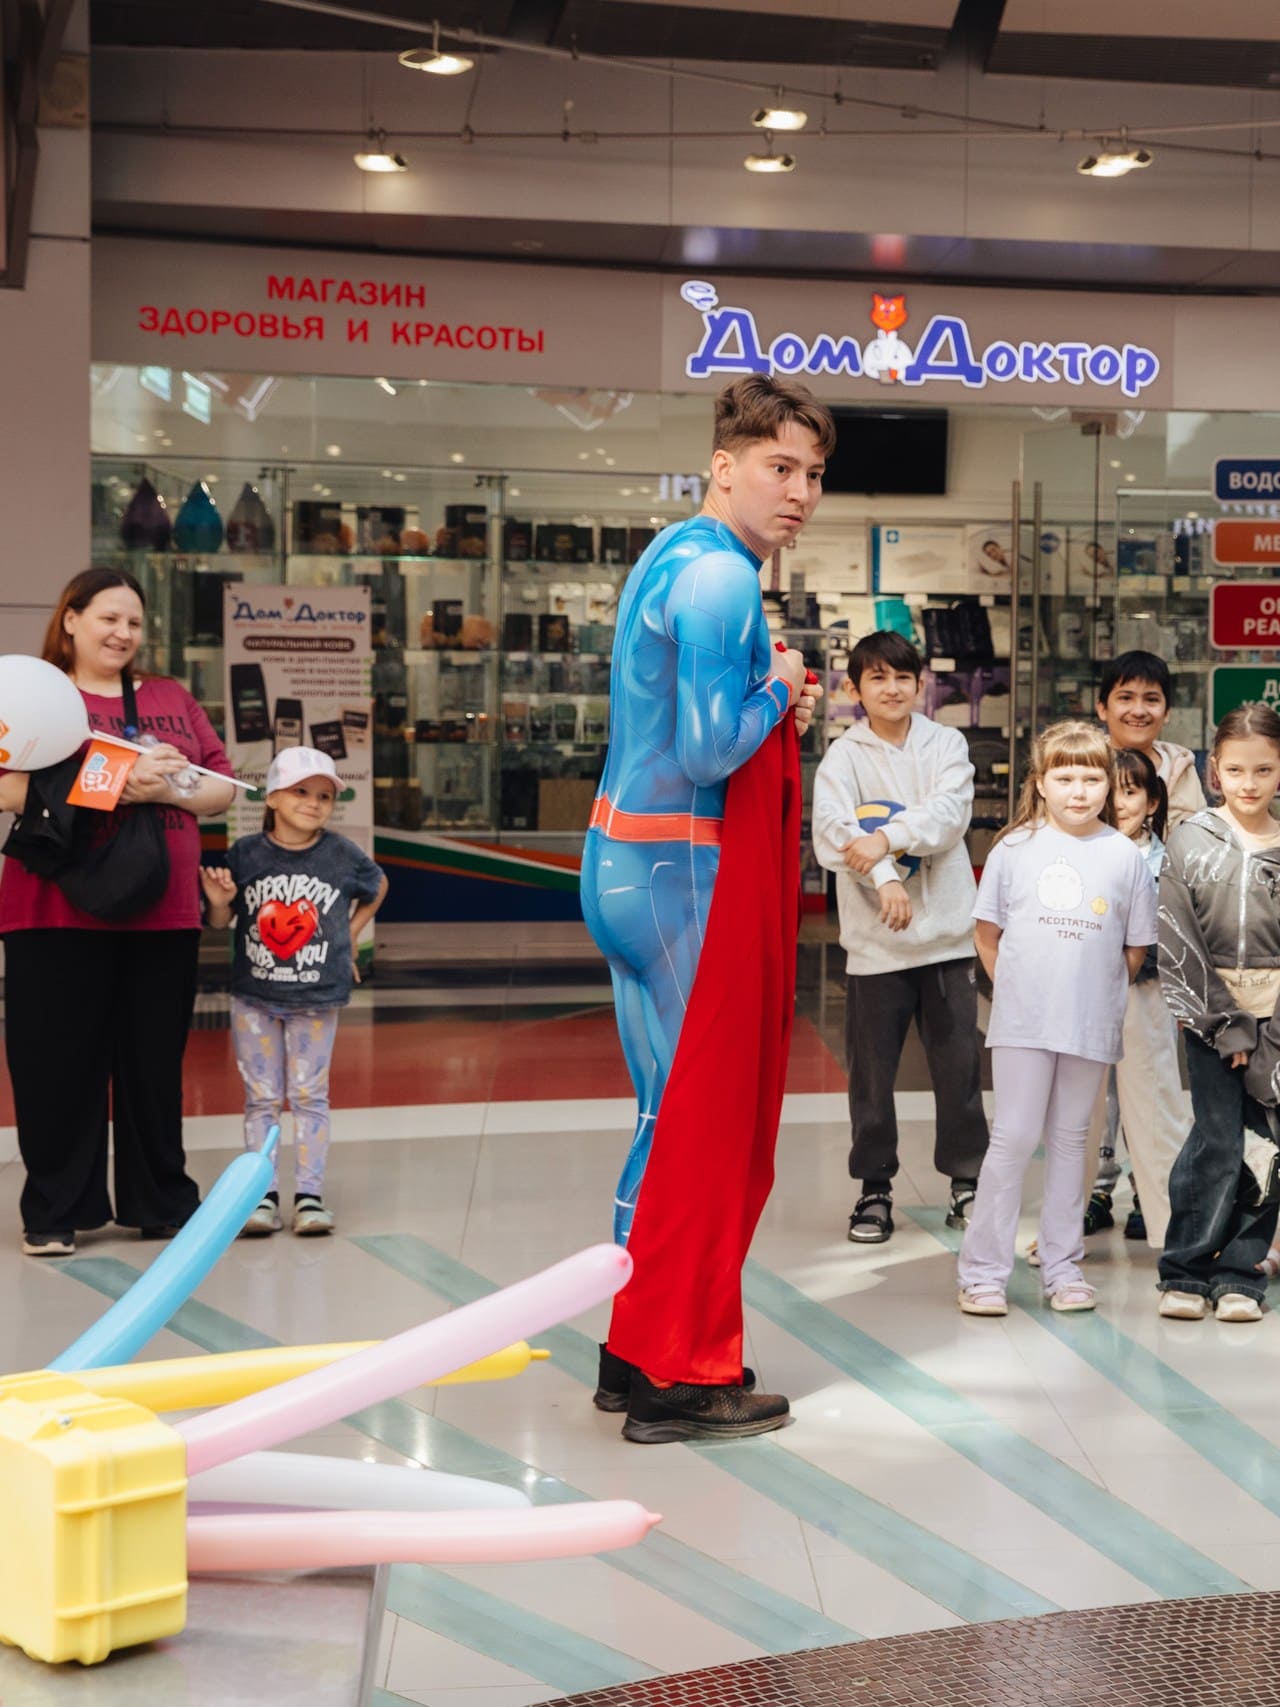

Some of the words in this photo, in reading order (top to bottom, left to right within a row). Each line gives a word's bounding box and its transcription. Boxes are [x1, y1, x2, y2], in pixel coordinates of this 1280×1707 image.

[267, 275, 426, 308] МАГАЗИН
[138, 306, 325, 341] ЗДОРОВЬЯ
[347, 318, 369, 344] И
[391, 321, 545, 353] КРАСОТЫ
[687, 308, 865, 378] Дом
[901, 314, 1160, 398] Доктор
[232, 602, 282, 620] Дом
[294, 604, 366, 623] Доктор
[139, 715, 193, 740] HELL
[244, 873, 341, 916] EVERYBODY
[1038, 916, 1103, 931] MEDITATION
[1056, 930, 1085, 941] TIME
